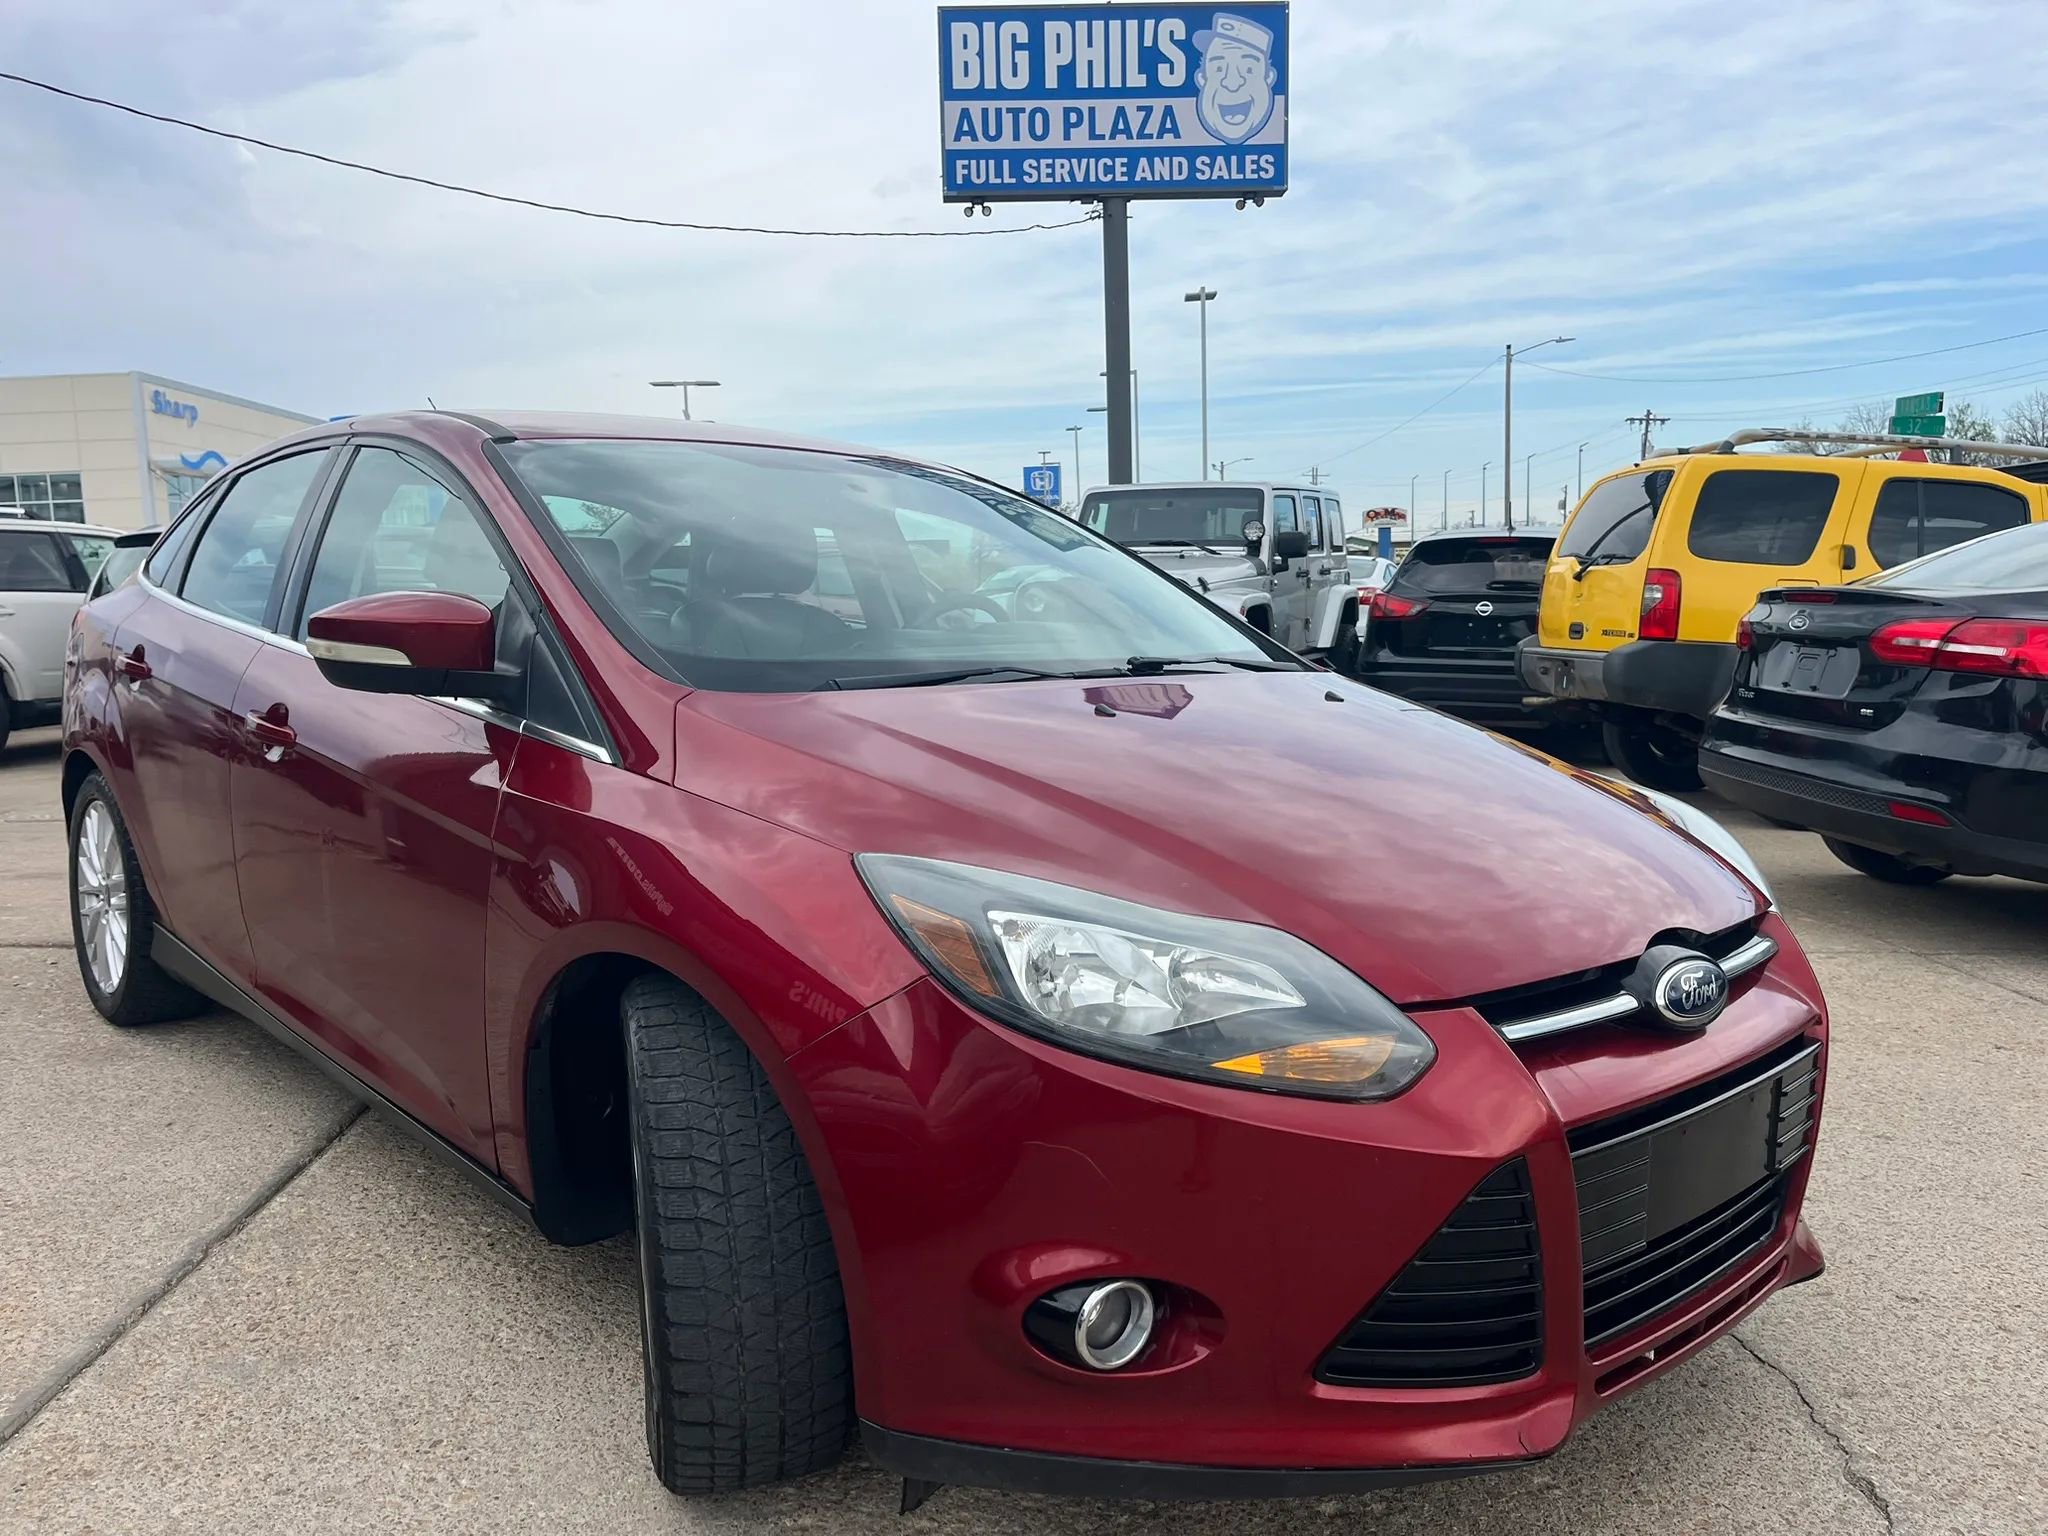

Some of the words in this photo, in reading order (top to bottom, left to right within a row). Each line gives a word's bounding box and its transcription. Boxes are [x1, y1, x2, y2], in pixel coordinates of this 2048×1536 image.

[950, 20, 1030, 90] BIG
[1043, 17, 1187, 89] PHIL'S
[953, 106, 1051, 142] AUTO
[1062, 104, 1182, 141] PLAZA
[955, 159, 1017, 185] FULL
[1022, 157, 1129, 184] SERVICE
[1134, 156, 1189, 182] AND
[1195, 154, 1275, 180] SALES
[150, 388, 199, 430] Sharp
[1680, 970, 1719, 1010] Ford
